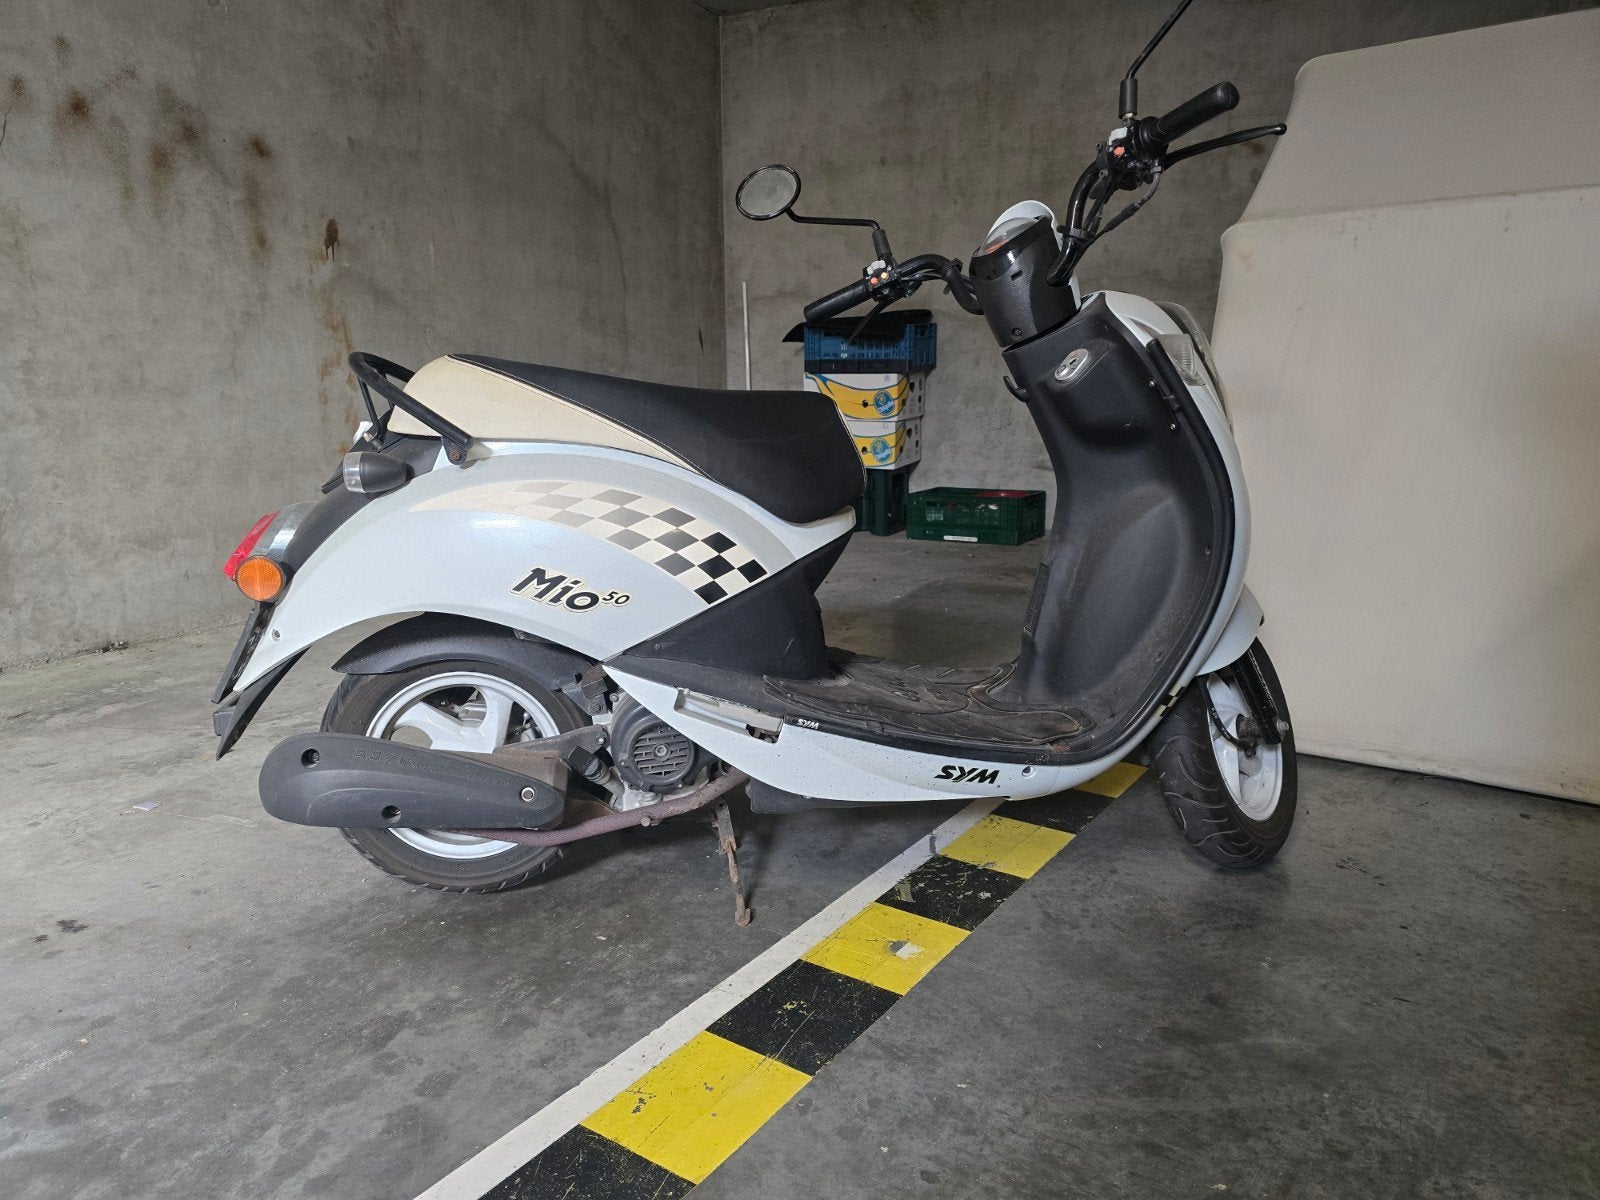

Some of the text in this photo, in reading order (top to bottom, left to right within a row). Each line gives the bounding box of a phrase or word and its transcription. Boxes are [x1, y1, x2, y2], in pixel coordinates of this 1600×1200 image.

[511, 566, 631, 611] Mio 50
[797, 718, 819, 730] SYM
[933, 764, 1000, 784] SYM
